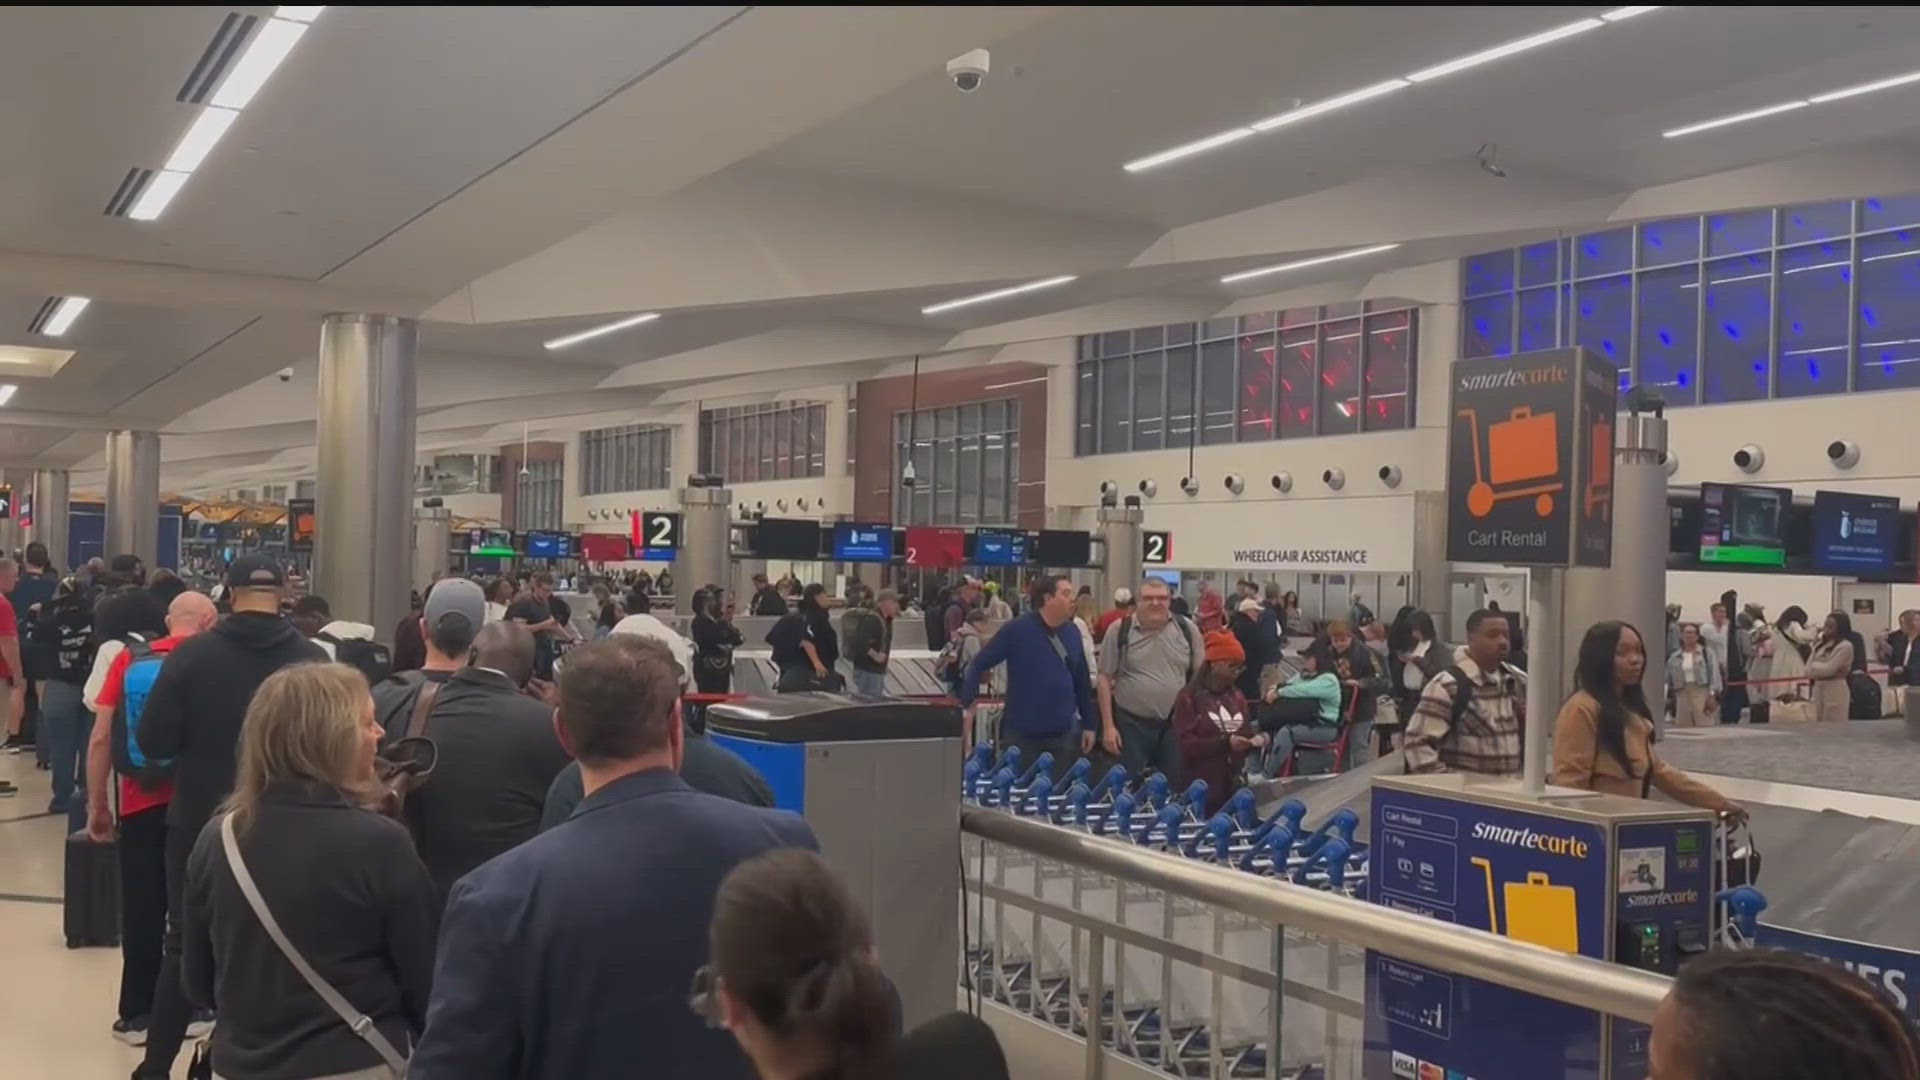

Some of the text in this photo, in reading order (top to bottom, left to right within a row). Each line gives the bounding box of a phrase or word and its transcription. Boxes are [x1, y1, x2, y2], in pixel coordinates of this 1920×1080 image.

[1459, 365, 1568, 391] smartecarte
[650, 518, 672, 546] 2
[1468, 529, 1547, 547] Cart Rental
[906, 547, 918, 564] 2
[1146, 535, 1163, 560] 2
[1234, 550, 1367, 564] WHEELCHAIR ASSISTANCE
[1472, 821, 1588, 858] smartecarte
[1626, 889, 1697, 907] smartecarte
[1395, 1059, 1414, 1073] VISA
